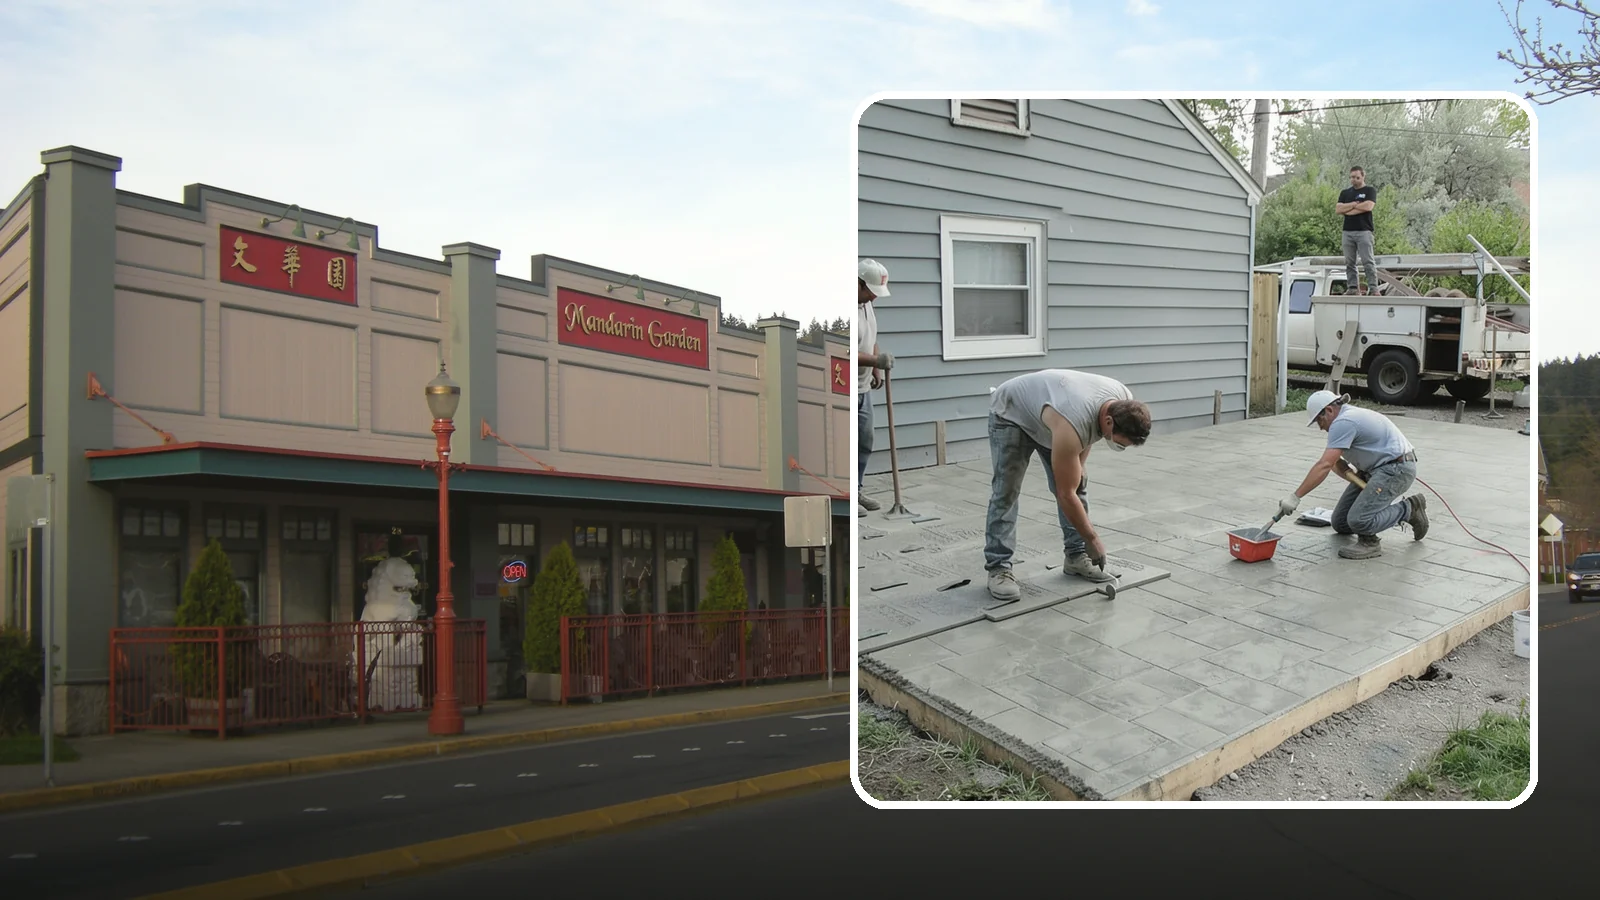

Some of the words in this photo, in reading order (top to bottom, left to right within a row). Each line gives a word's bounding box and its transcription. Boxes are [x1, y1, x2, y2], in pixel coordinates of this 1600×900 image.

[231, 235, 346, 291] 文華園
[564, 302, 644, 341] Mandarin
[647, 320, 701, 352] Garden
[503, 565, 527, 578] OPEN
